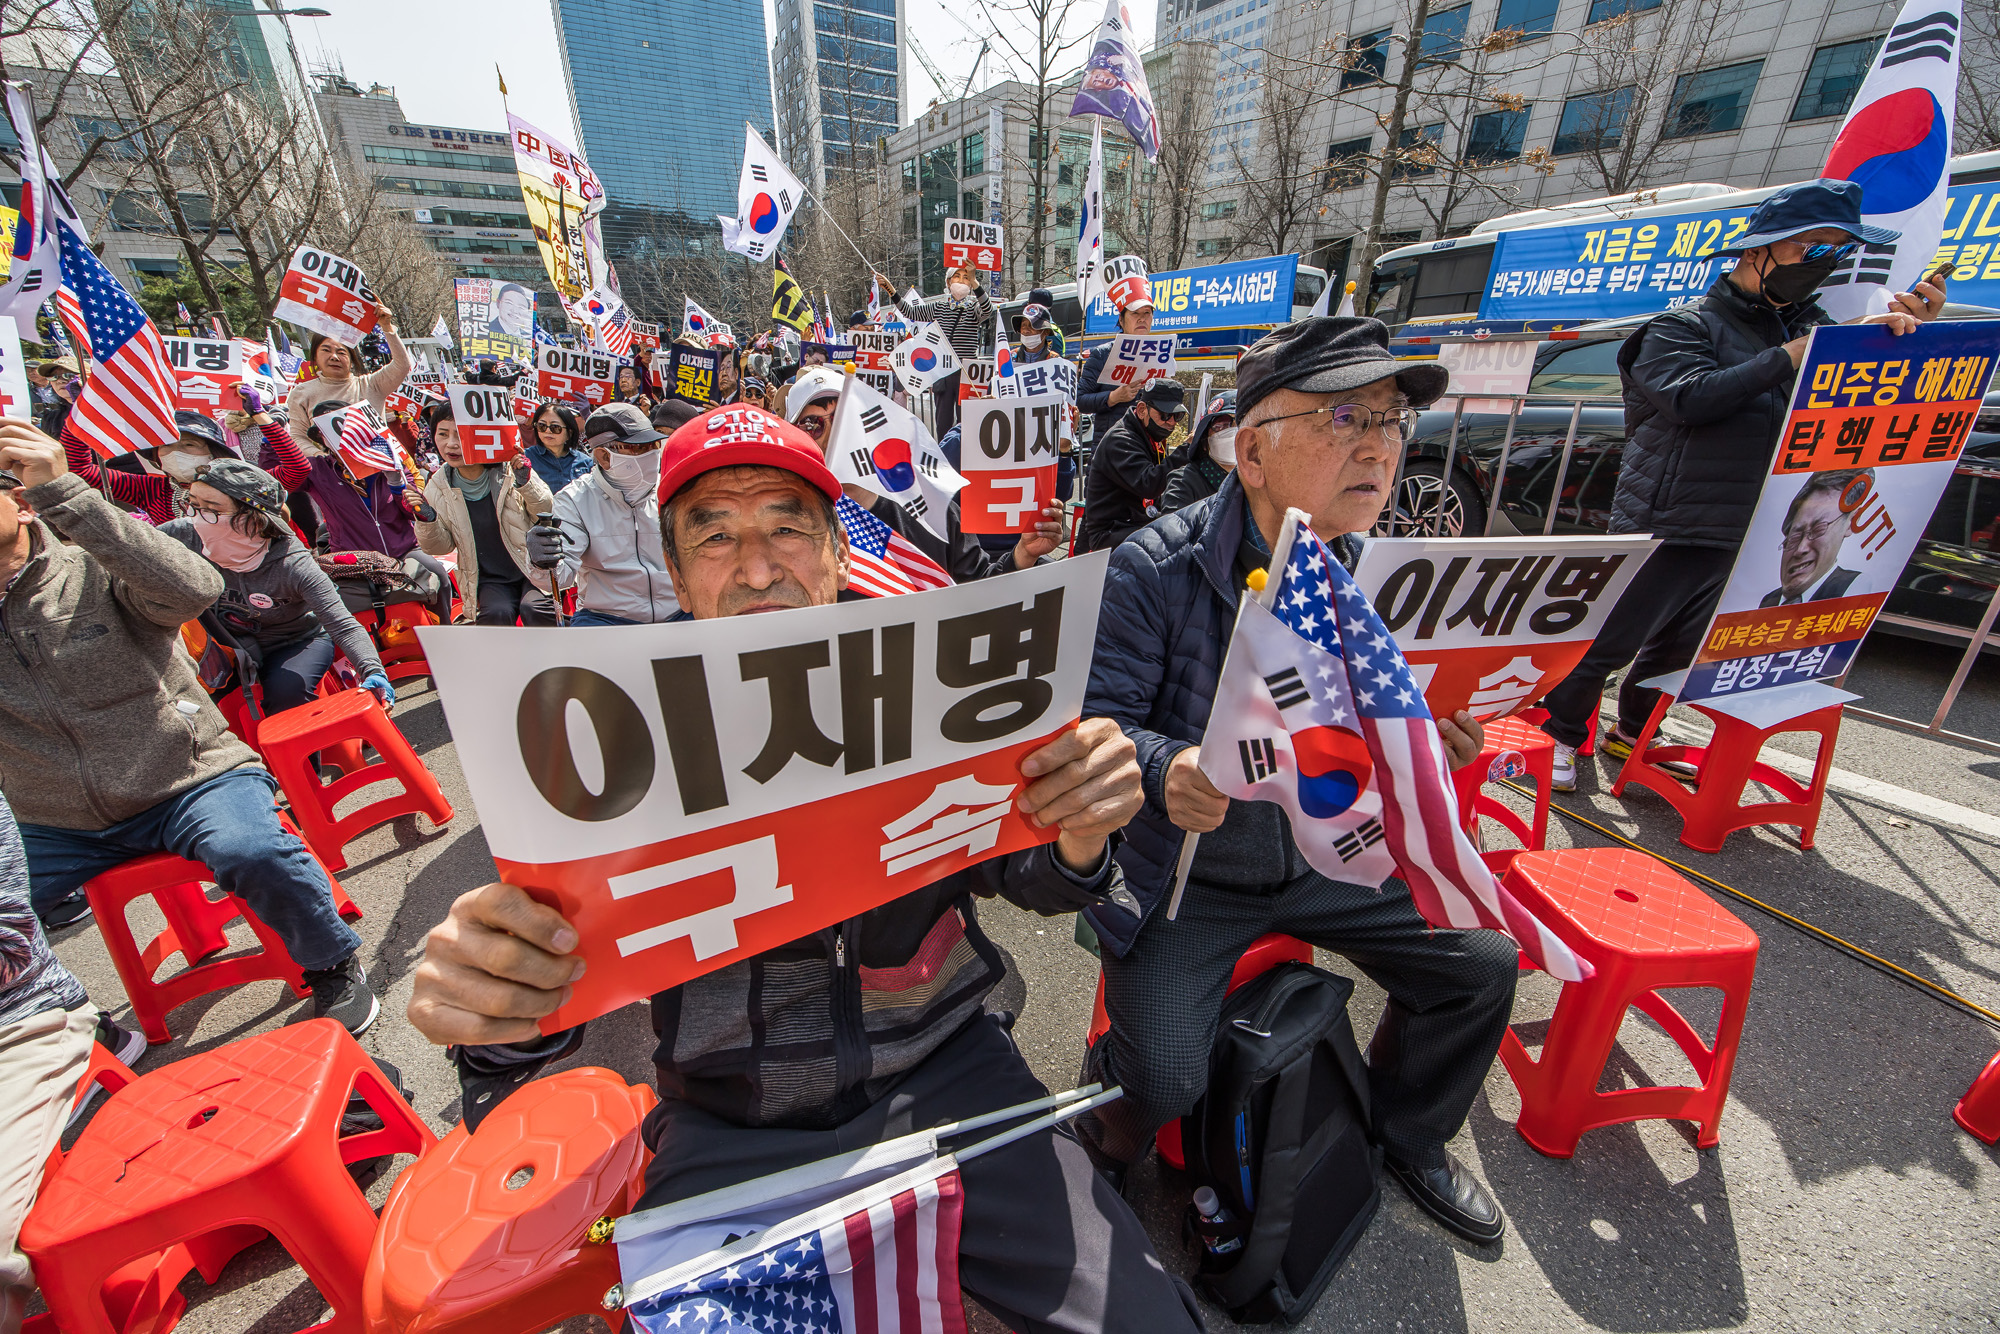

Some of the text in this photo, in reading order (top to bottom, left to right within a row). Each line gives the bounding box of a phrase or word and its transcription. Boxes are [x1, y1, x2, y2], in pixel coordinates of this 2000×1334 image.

[403, 126, 425, 138] IBS
[950, 223, 997, 245] 이재명
[1578, 224, 1660, 264] 지금은
[1193, 269, 1278, 309] 구속수사하라
[1490, 267, 1605, 298] 반국가세력으로
[1606, 264, 1647, 293] 부터
[1649, 260, 1713, 292] 국민이
[632, 322, 657, 335] 이재명
[852, 333, 895, 352] 이재명
[164, 340, 230, 371] 재명
[546, 349, 611, 379] 이재명
[680, 353, 715, 370] 이재명
[1118, 339, 1174, 364] 민주당
[411, 373, 441, 384] 이재명
[677, 364, 713, 387] 즉시
[1807, 355, 1990, 409] 민주당 해체!
[395, 383, 423, 403] 재명
[464, 390, 514, 421] 이재
[675, 380, 711, 403] 체포
[707, 409, 780, 431] STOP
[725, 422, 765, 434] THE
[979, 405, 1060, 463] 이재
[987, 476, 1039, 527] 구
[1837, 473, 1898, 561] OUT!
[1374, 554, 1629, 640] 이재명
[1707, 606, 1877, 651] 대북송금 종북세력!
[1710, 644, 1836, 694] 법정구속!
[516, 586, 1066, 822] 이재명
